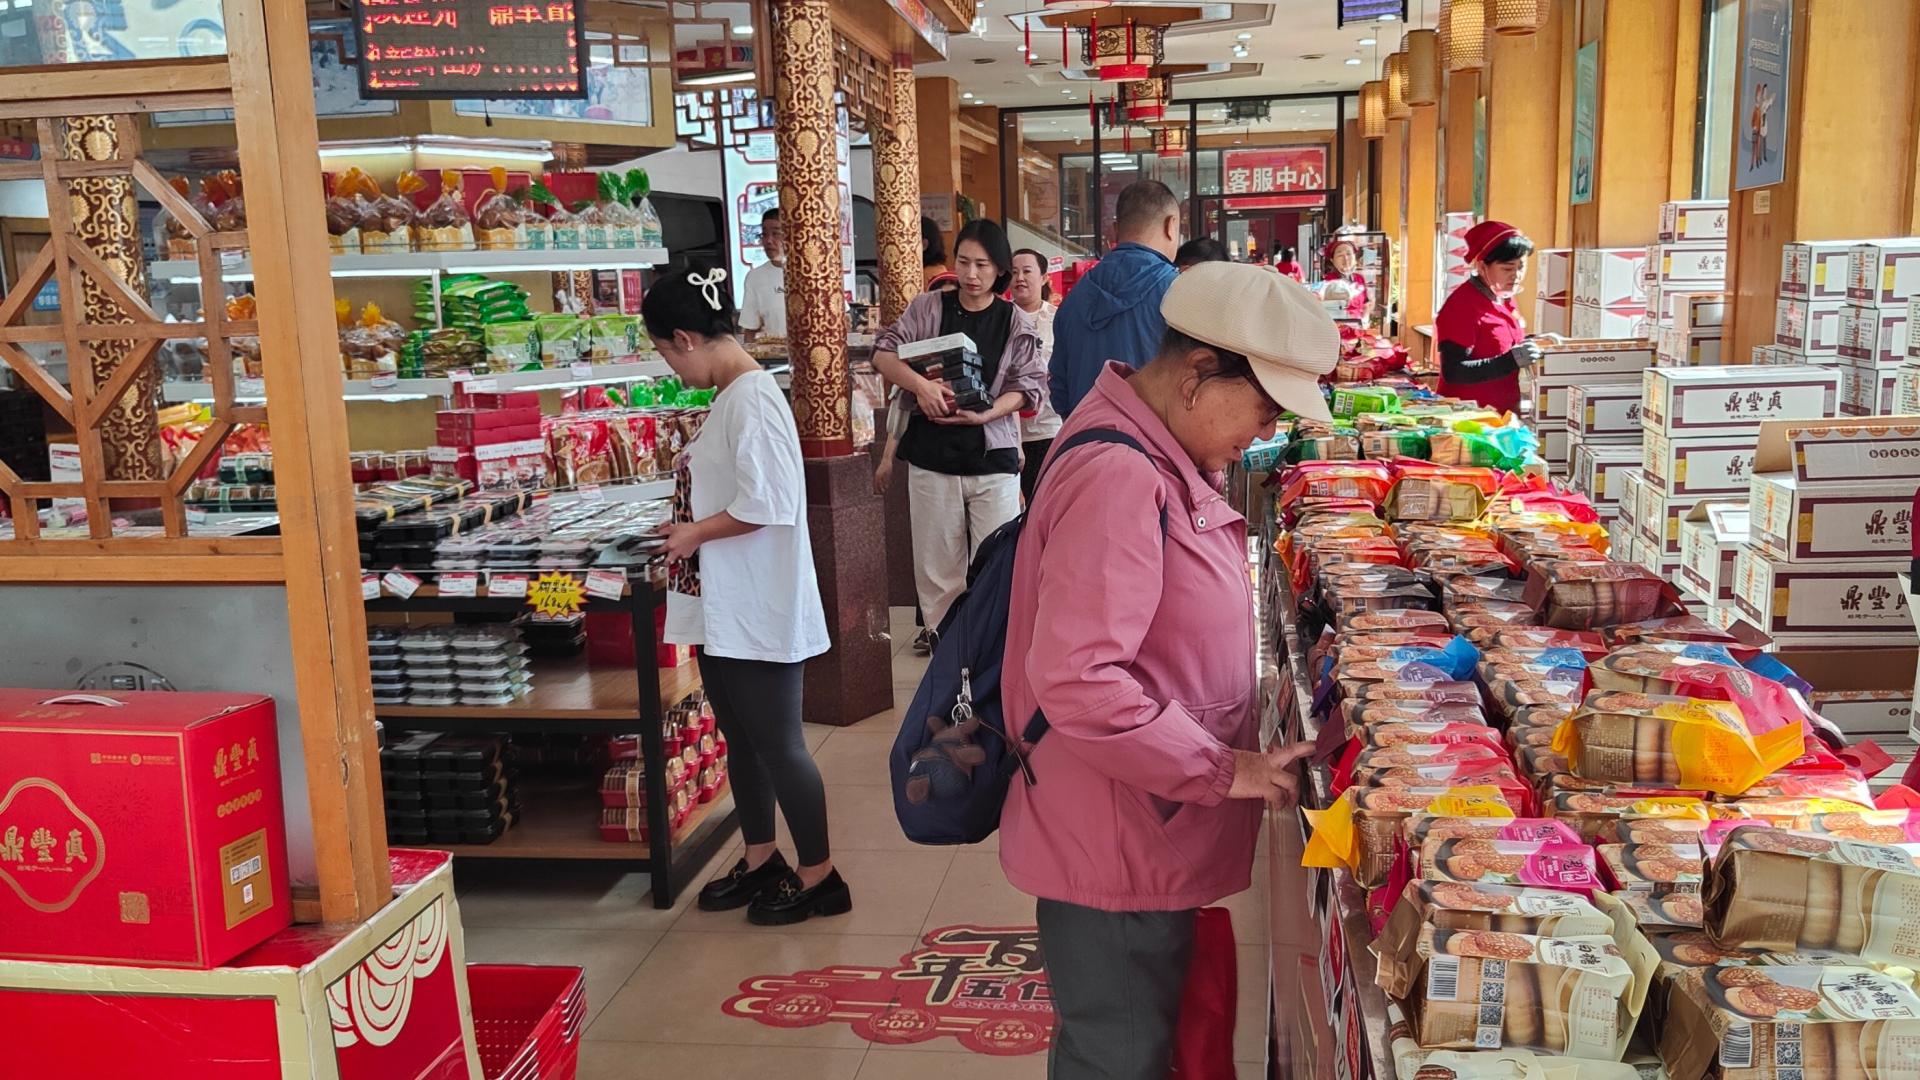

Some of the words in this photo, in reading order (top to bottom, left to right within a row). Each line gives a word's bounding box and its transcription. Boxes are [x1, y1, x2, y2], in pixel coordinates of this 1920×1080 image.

[1228, 165, 1322, 194] 客服中心
[775, 1003, 821, 1013] 2011
[877, 1019, 925, 1029] 2001
[984, 1030, 1034, 1040] 1949
